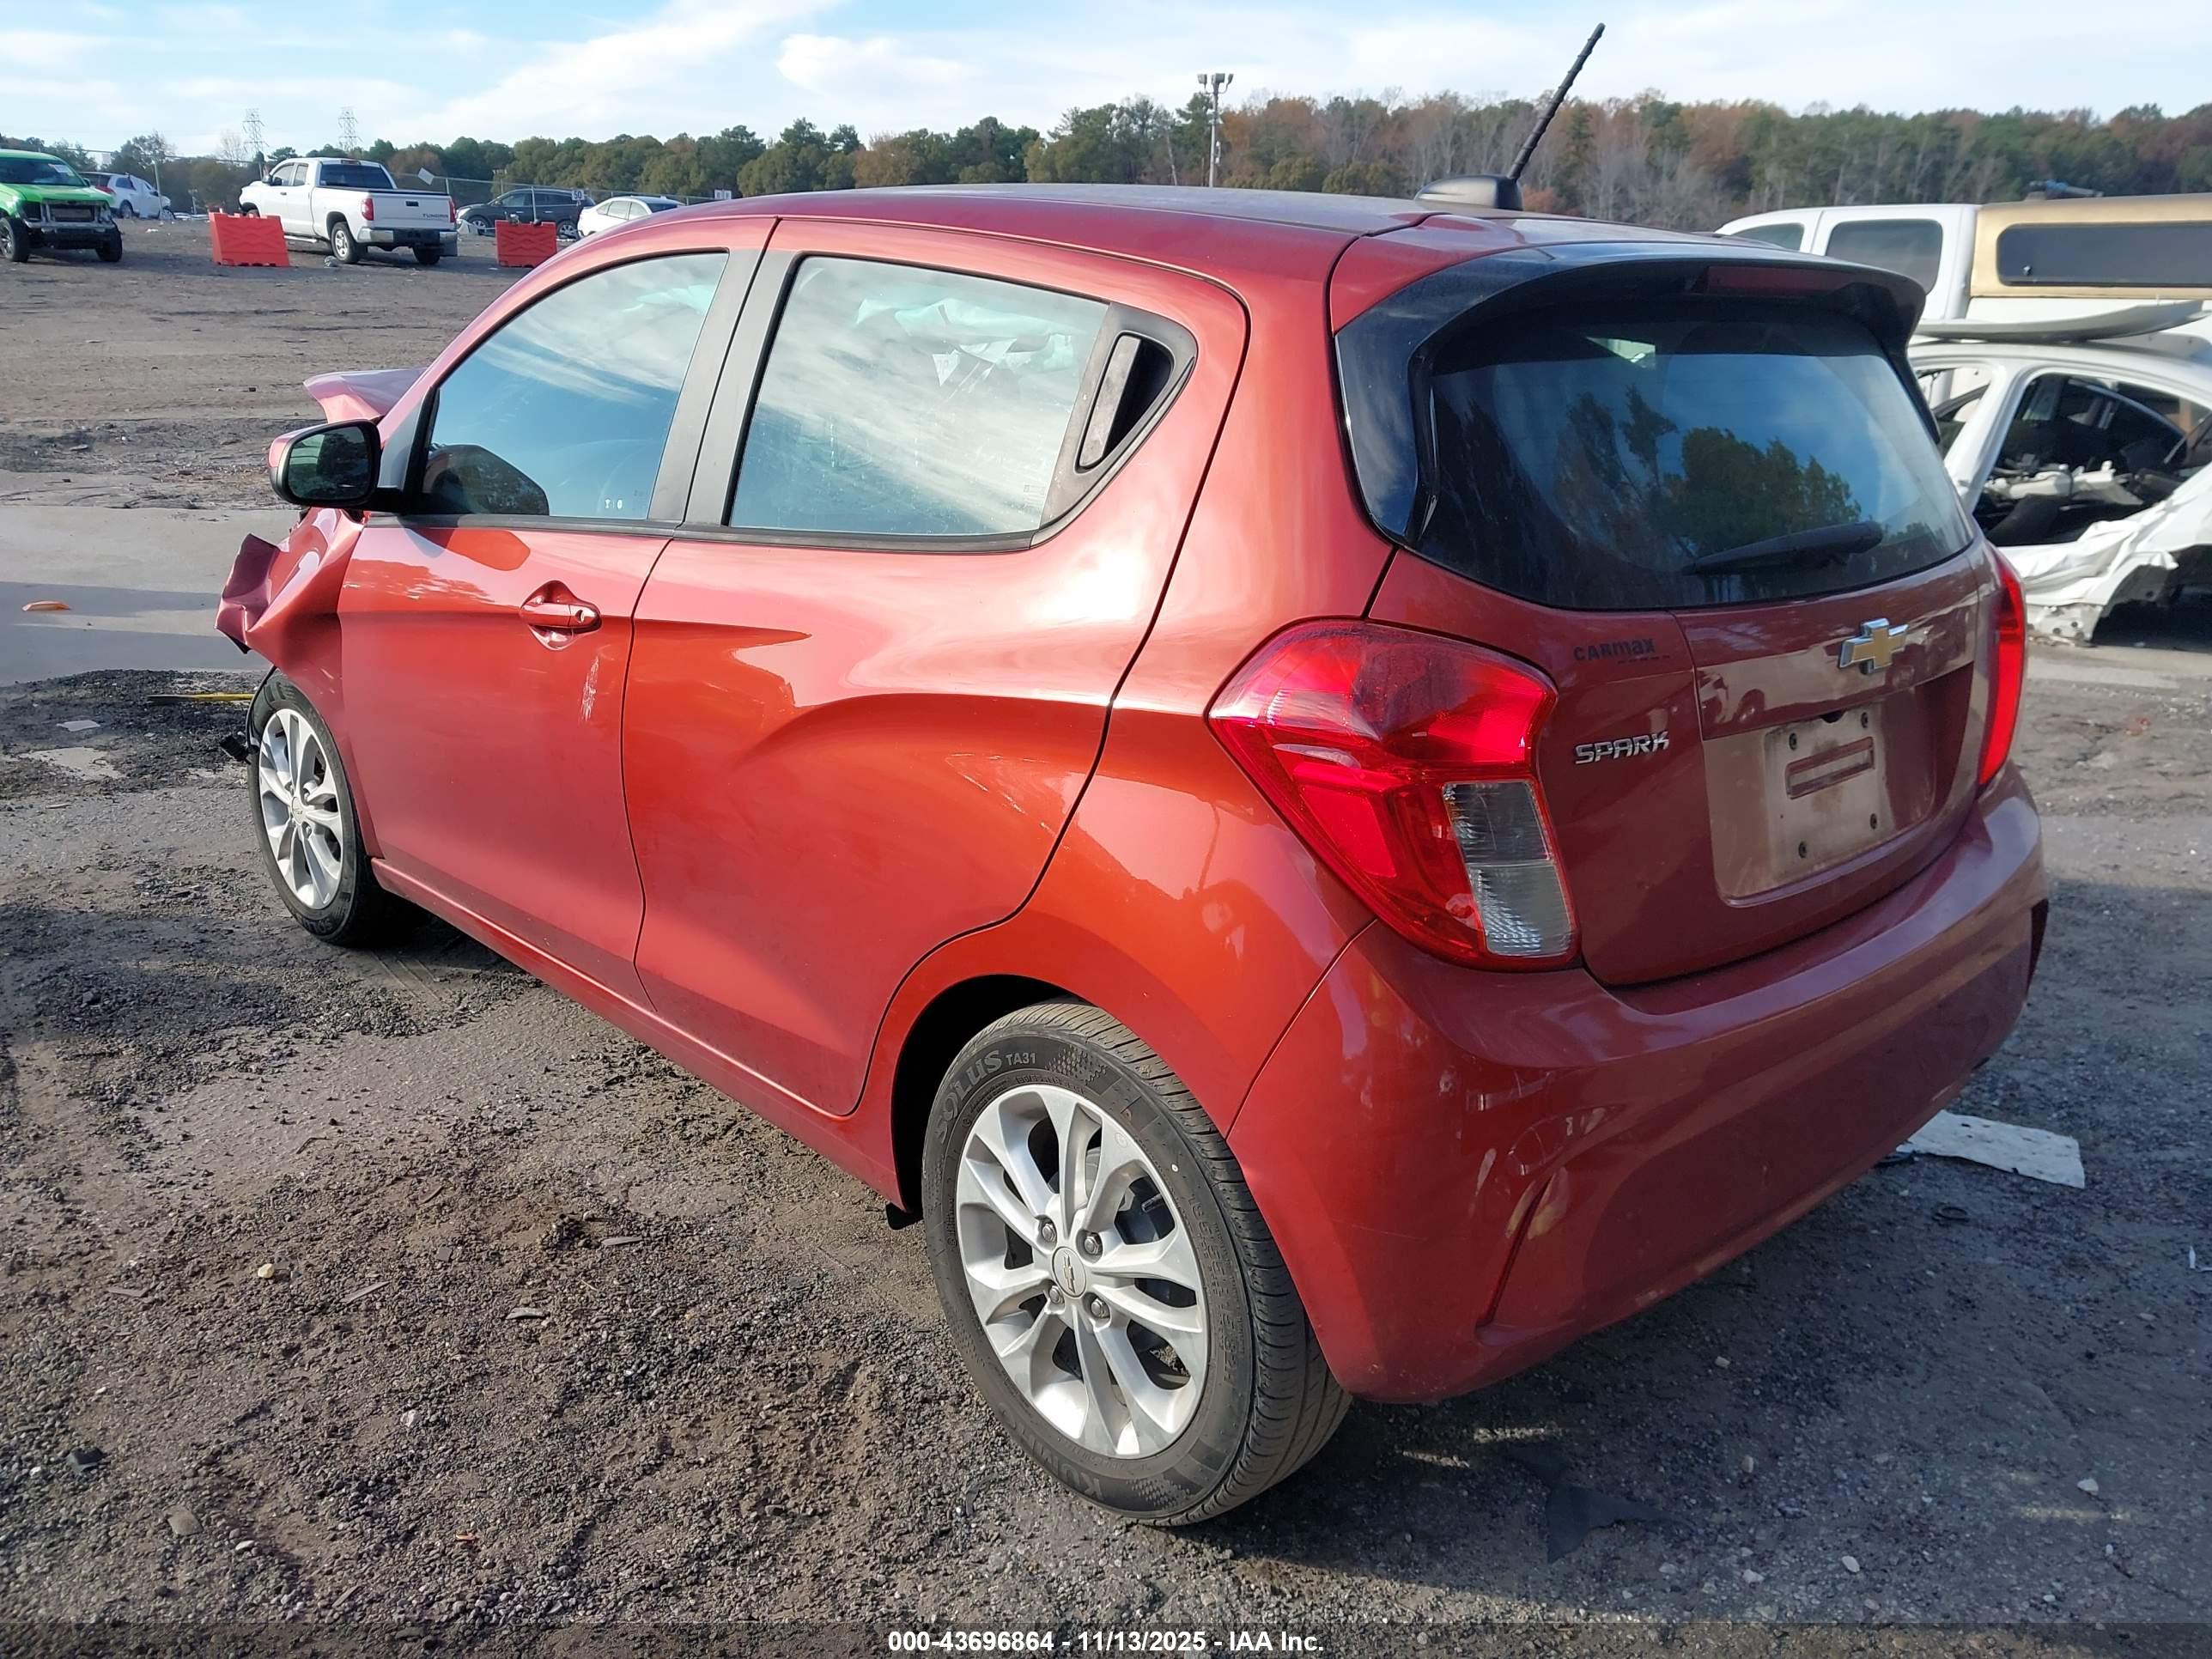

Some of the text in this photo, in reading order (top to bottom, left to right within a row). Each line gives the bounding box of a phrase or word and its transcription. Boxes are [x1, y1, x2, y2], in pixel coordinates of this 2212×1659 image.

[574, 191, 582, 199] 50
[1575, 730, 1669, 764] SPARK
[934, 1049, 1003, 1144] SOLUS
[1006, 1052, 1036, 1066] TA31
